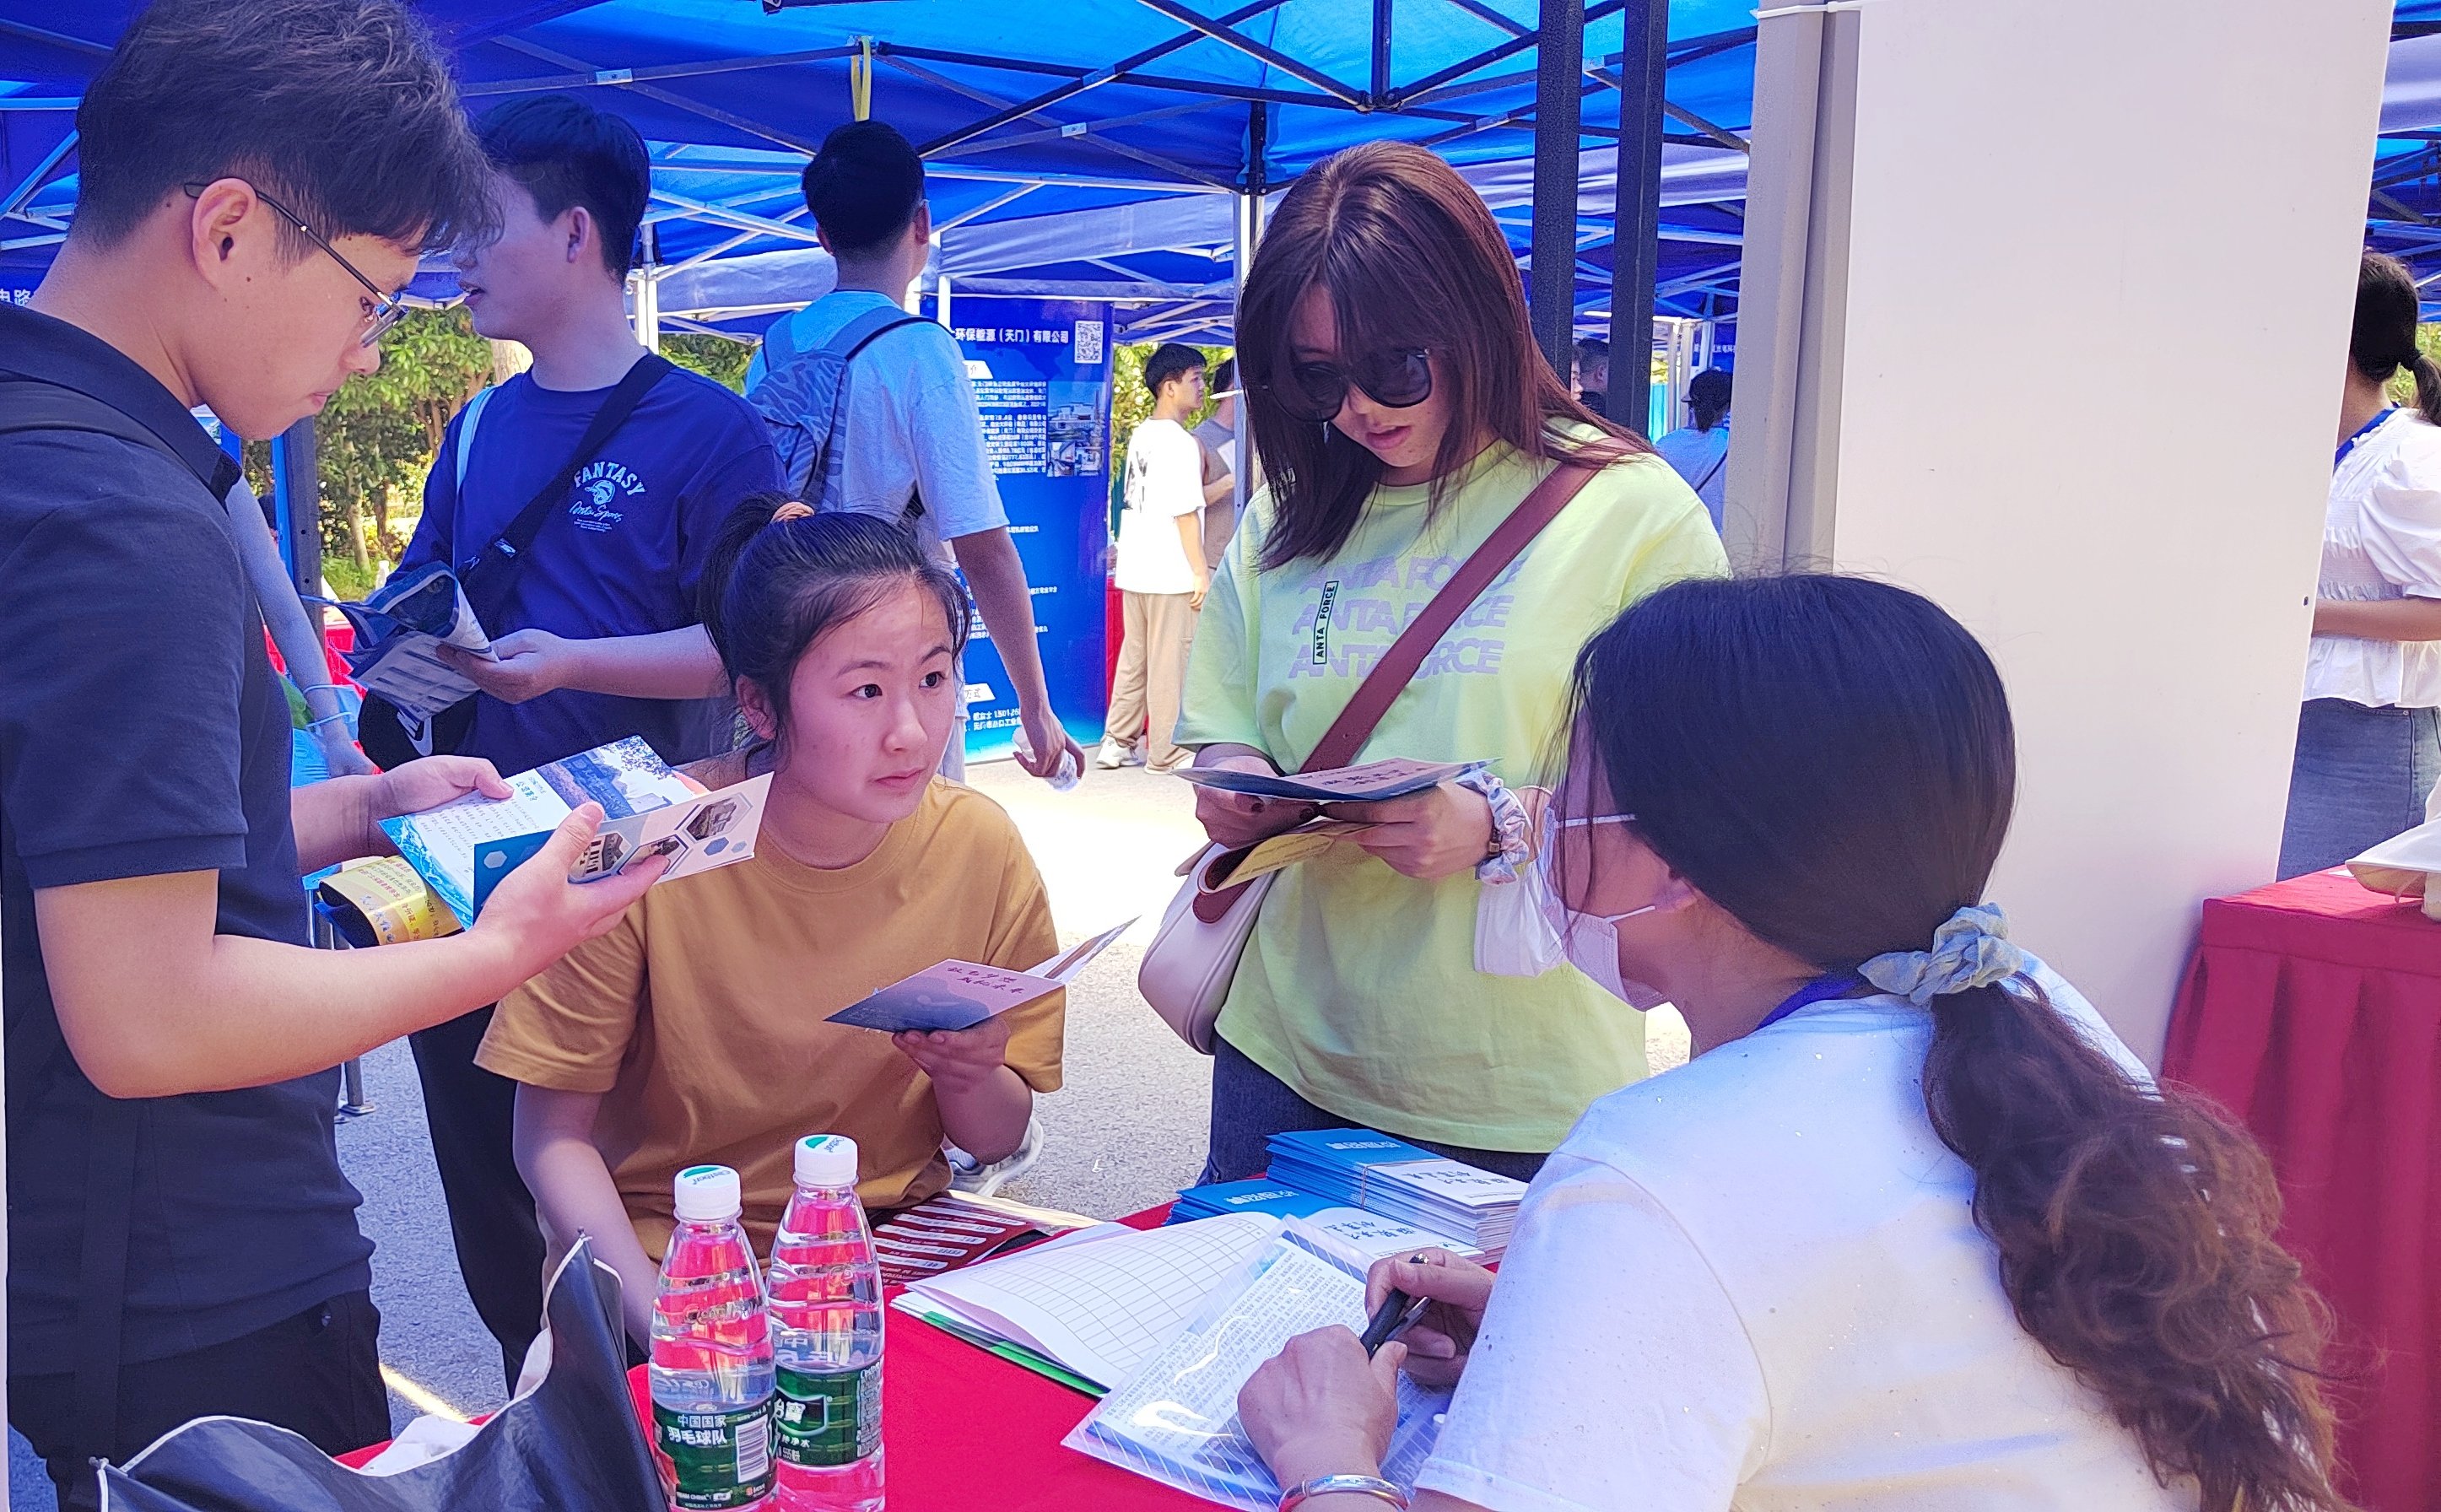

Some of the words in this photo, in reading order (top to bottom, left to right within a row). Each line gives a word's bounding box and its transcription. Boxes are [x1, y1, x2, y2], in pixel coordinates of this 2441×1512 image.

[574, 461, 646, 496] FANTASY
[1292, 597, 1398, 635] ANTA
[1319, 585, 1336, 619] FORCE
[1315, 626, 1326, 659] ANTA
[667, 1425, 727, 1445] 羽毛球队
[678, 1414, 727, 1428] 中国国家
